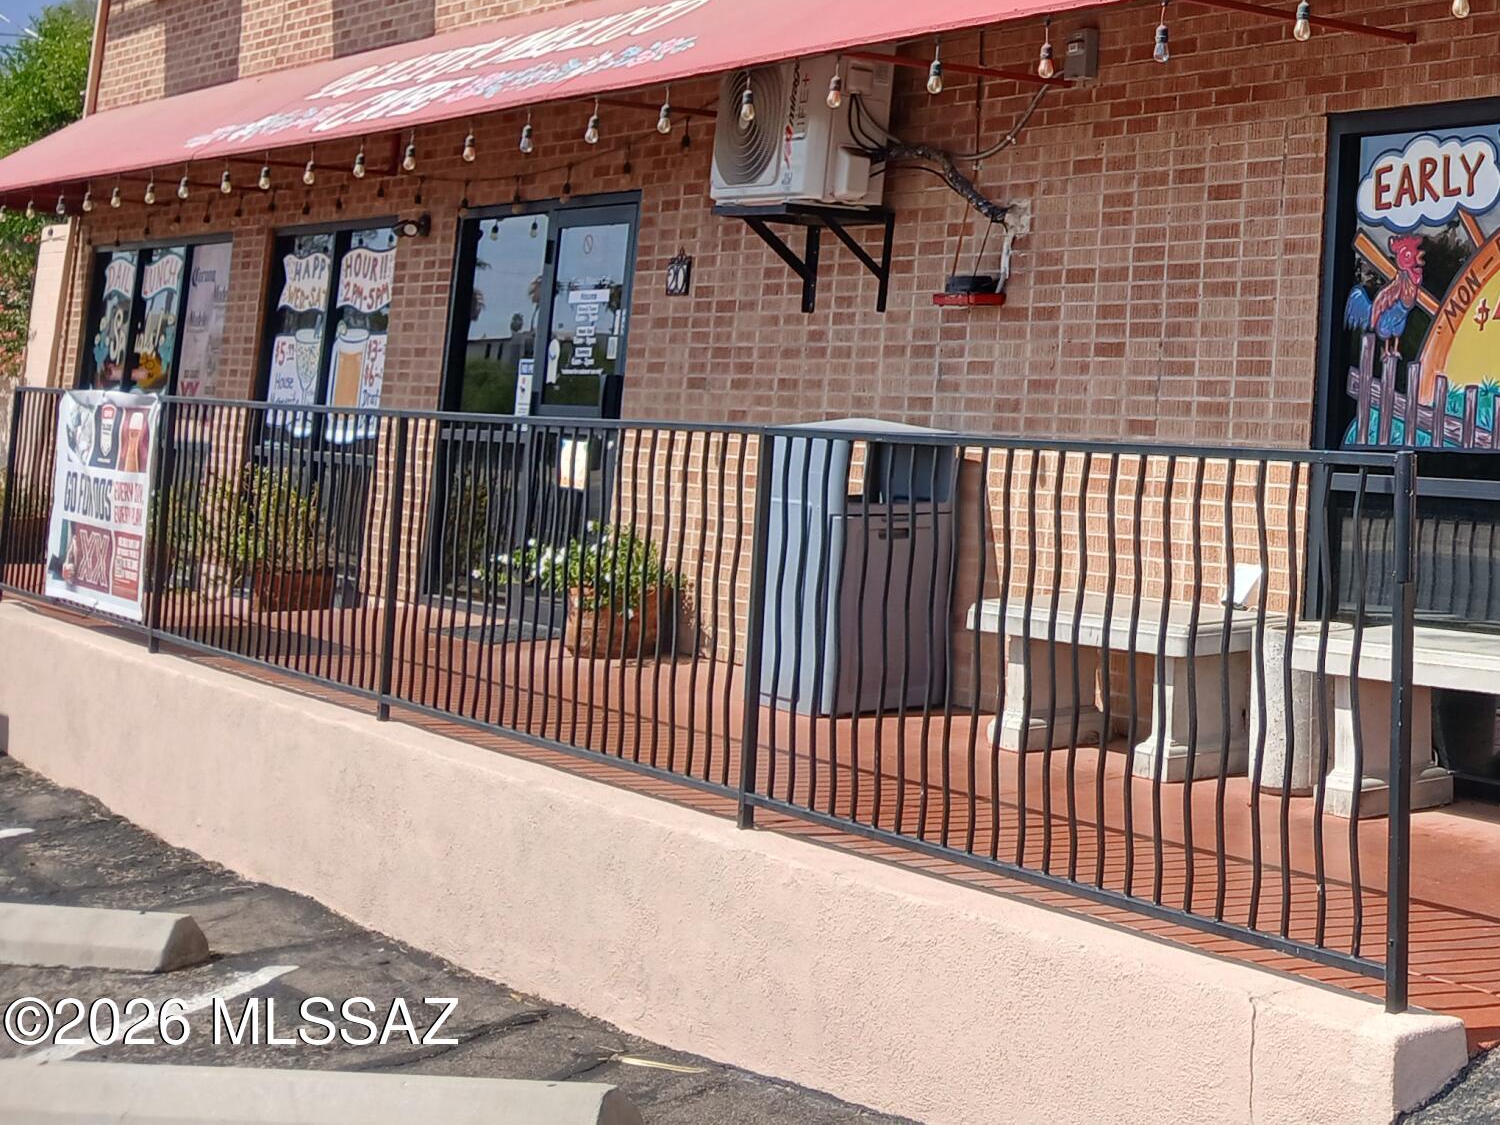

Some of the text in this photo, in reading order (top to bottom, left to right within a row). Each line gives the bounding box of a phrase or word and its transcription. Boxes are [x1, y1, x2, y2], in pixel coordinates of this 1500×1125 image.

[1374, 151, 1486, 211] EARLY
[107, 264, 130, 293] DAIL
[292, 254, 327, 281] HAPP
[64, 470, 78, 513] GO
[77, 528, 111, 588] XX
